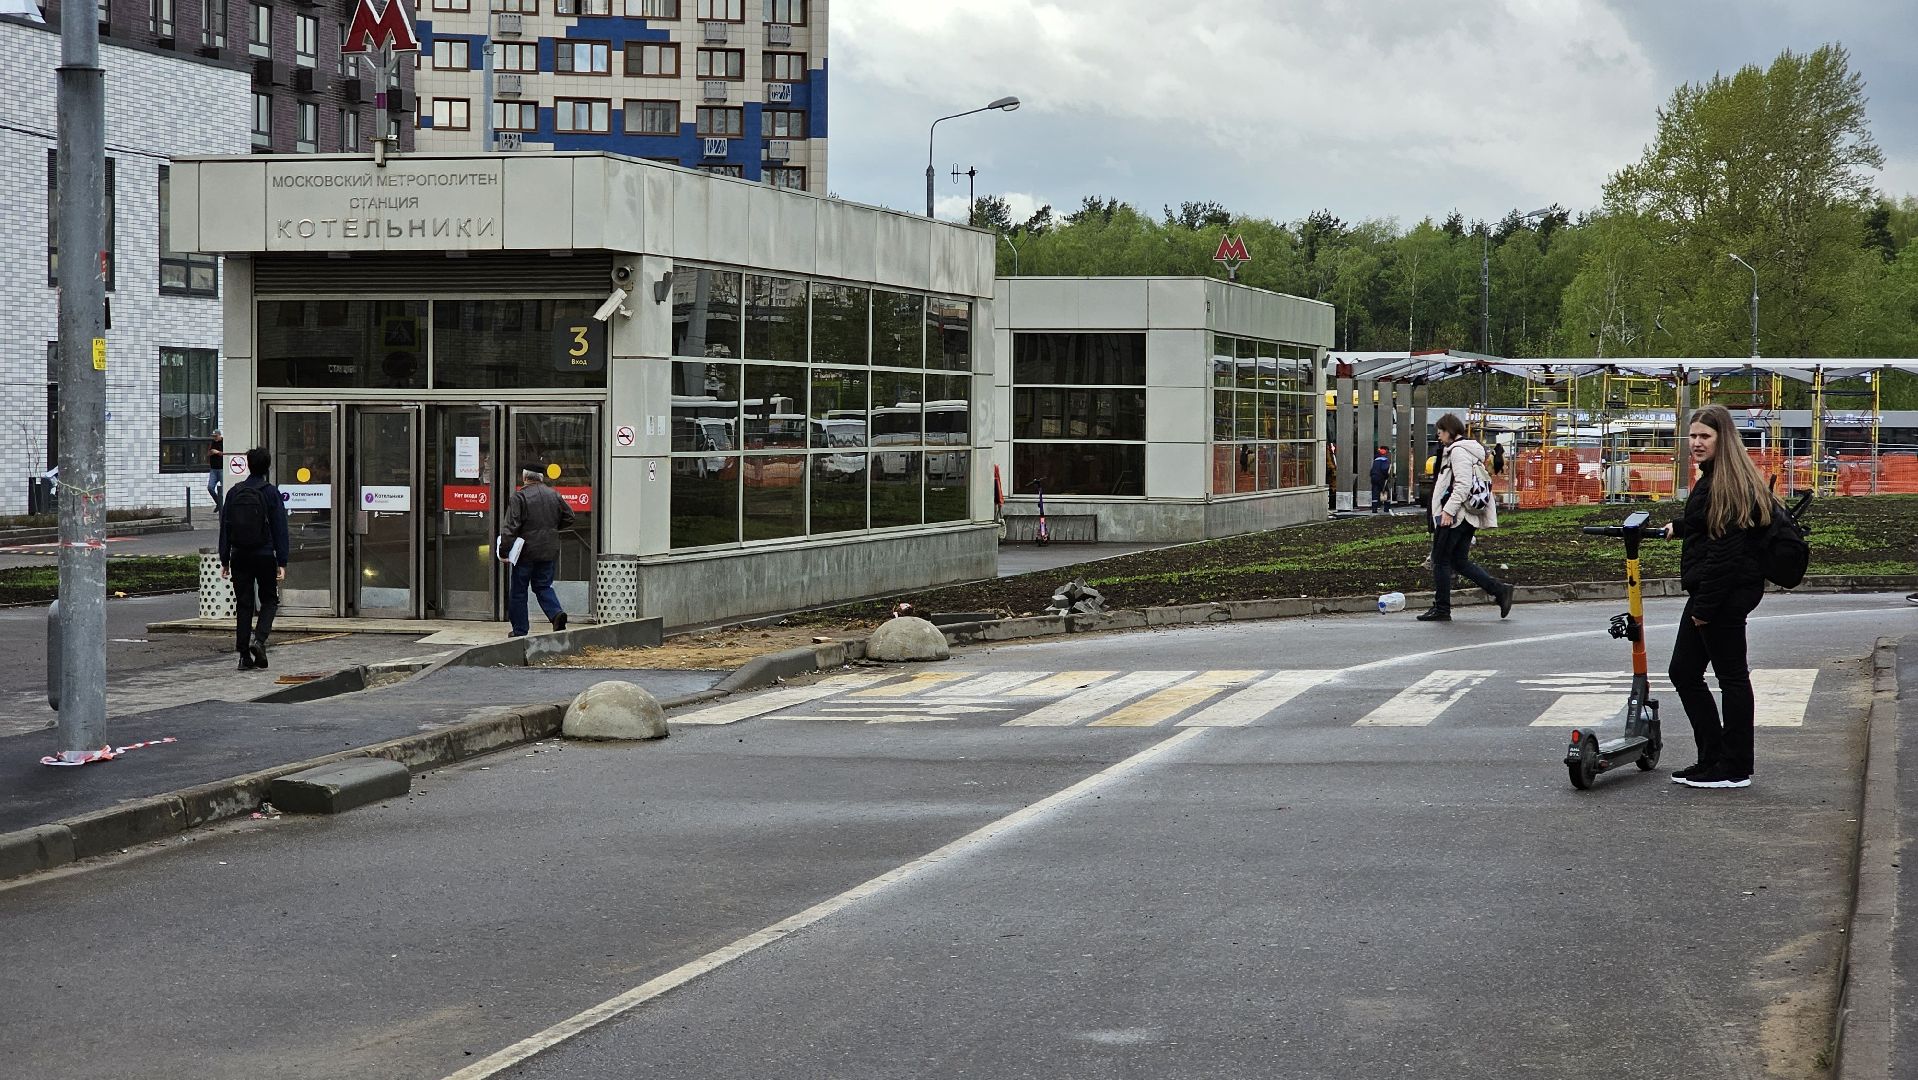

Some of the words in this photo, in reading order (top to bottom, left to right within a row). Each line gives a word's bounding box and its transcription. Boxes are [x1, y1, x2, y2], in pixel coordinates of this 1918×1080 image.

[272, 173, 373, 187] МОСКОВСКИЙ
[377, 173, 498, 187] МЕТРОПОЛИТЕН
[350, 197, 419, 211] СТАНЦИЯ
[277, 216, 495, 239] КОТЕЛЬНИКИ
[569, 326, 589, 357] 3
[571, 358, 587, 366] Вход
